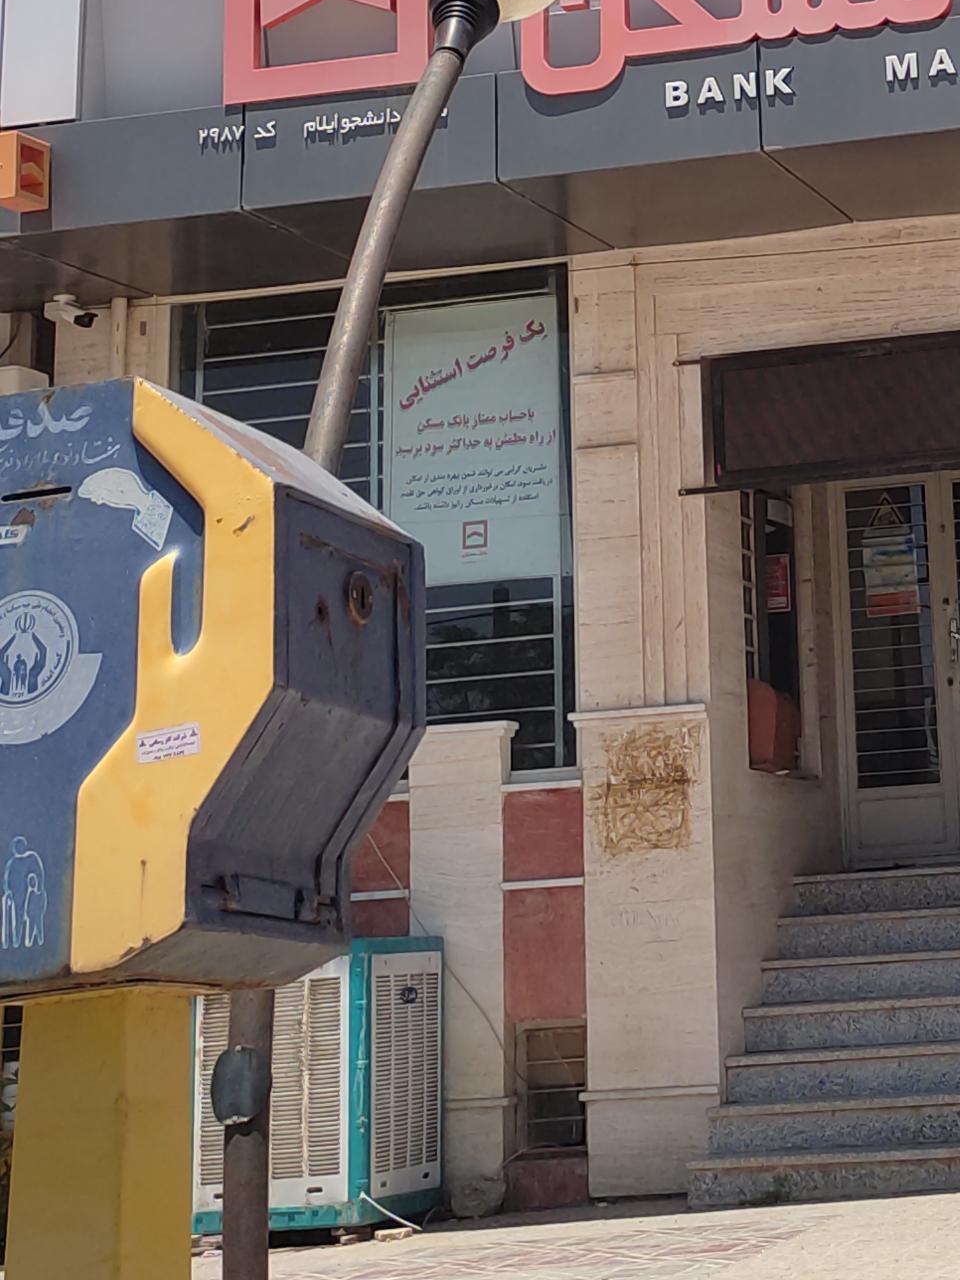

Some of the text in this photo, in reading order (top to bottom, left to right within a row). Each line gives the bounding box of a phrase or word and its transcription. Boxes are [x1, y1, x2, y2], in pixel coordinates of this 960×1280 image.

[664, 66, 796, 111] BANK
[254, 120, 277, 139] کد
[303, 111, 339, 138] ایلام
[519, 319, 549, 342] یک
[466, 330, 515, 370] فرصت
